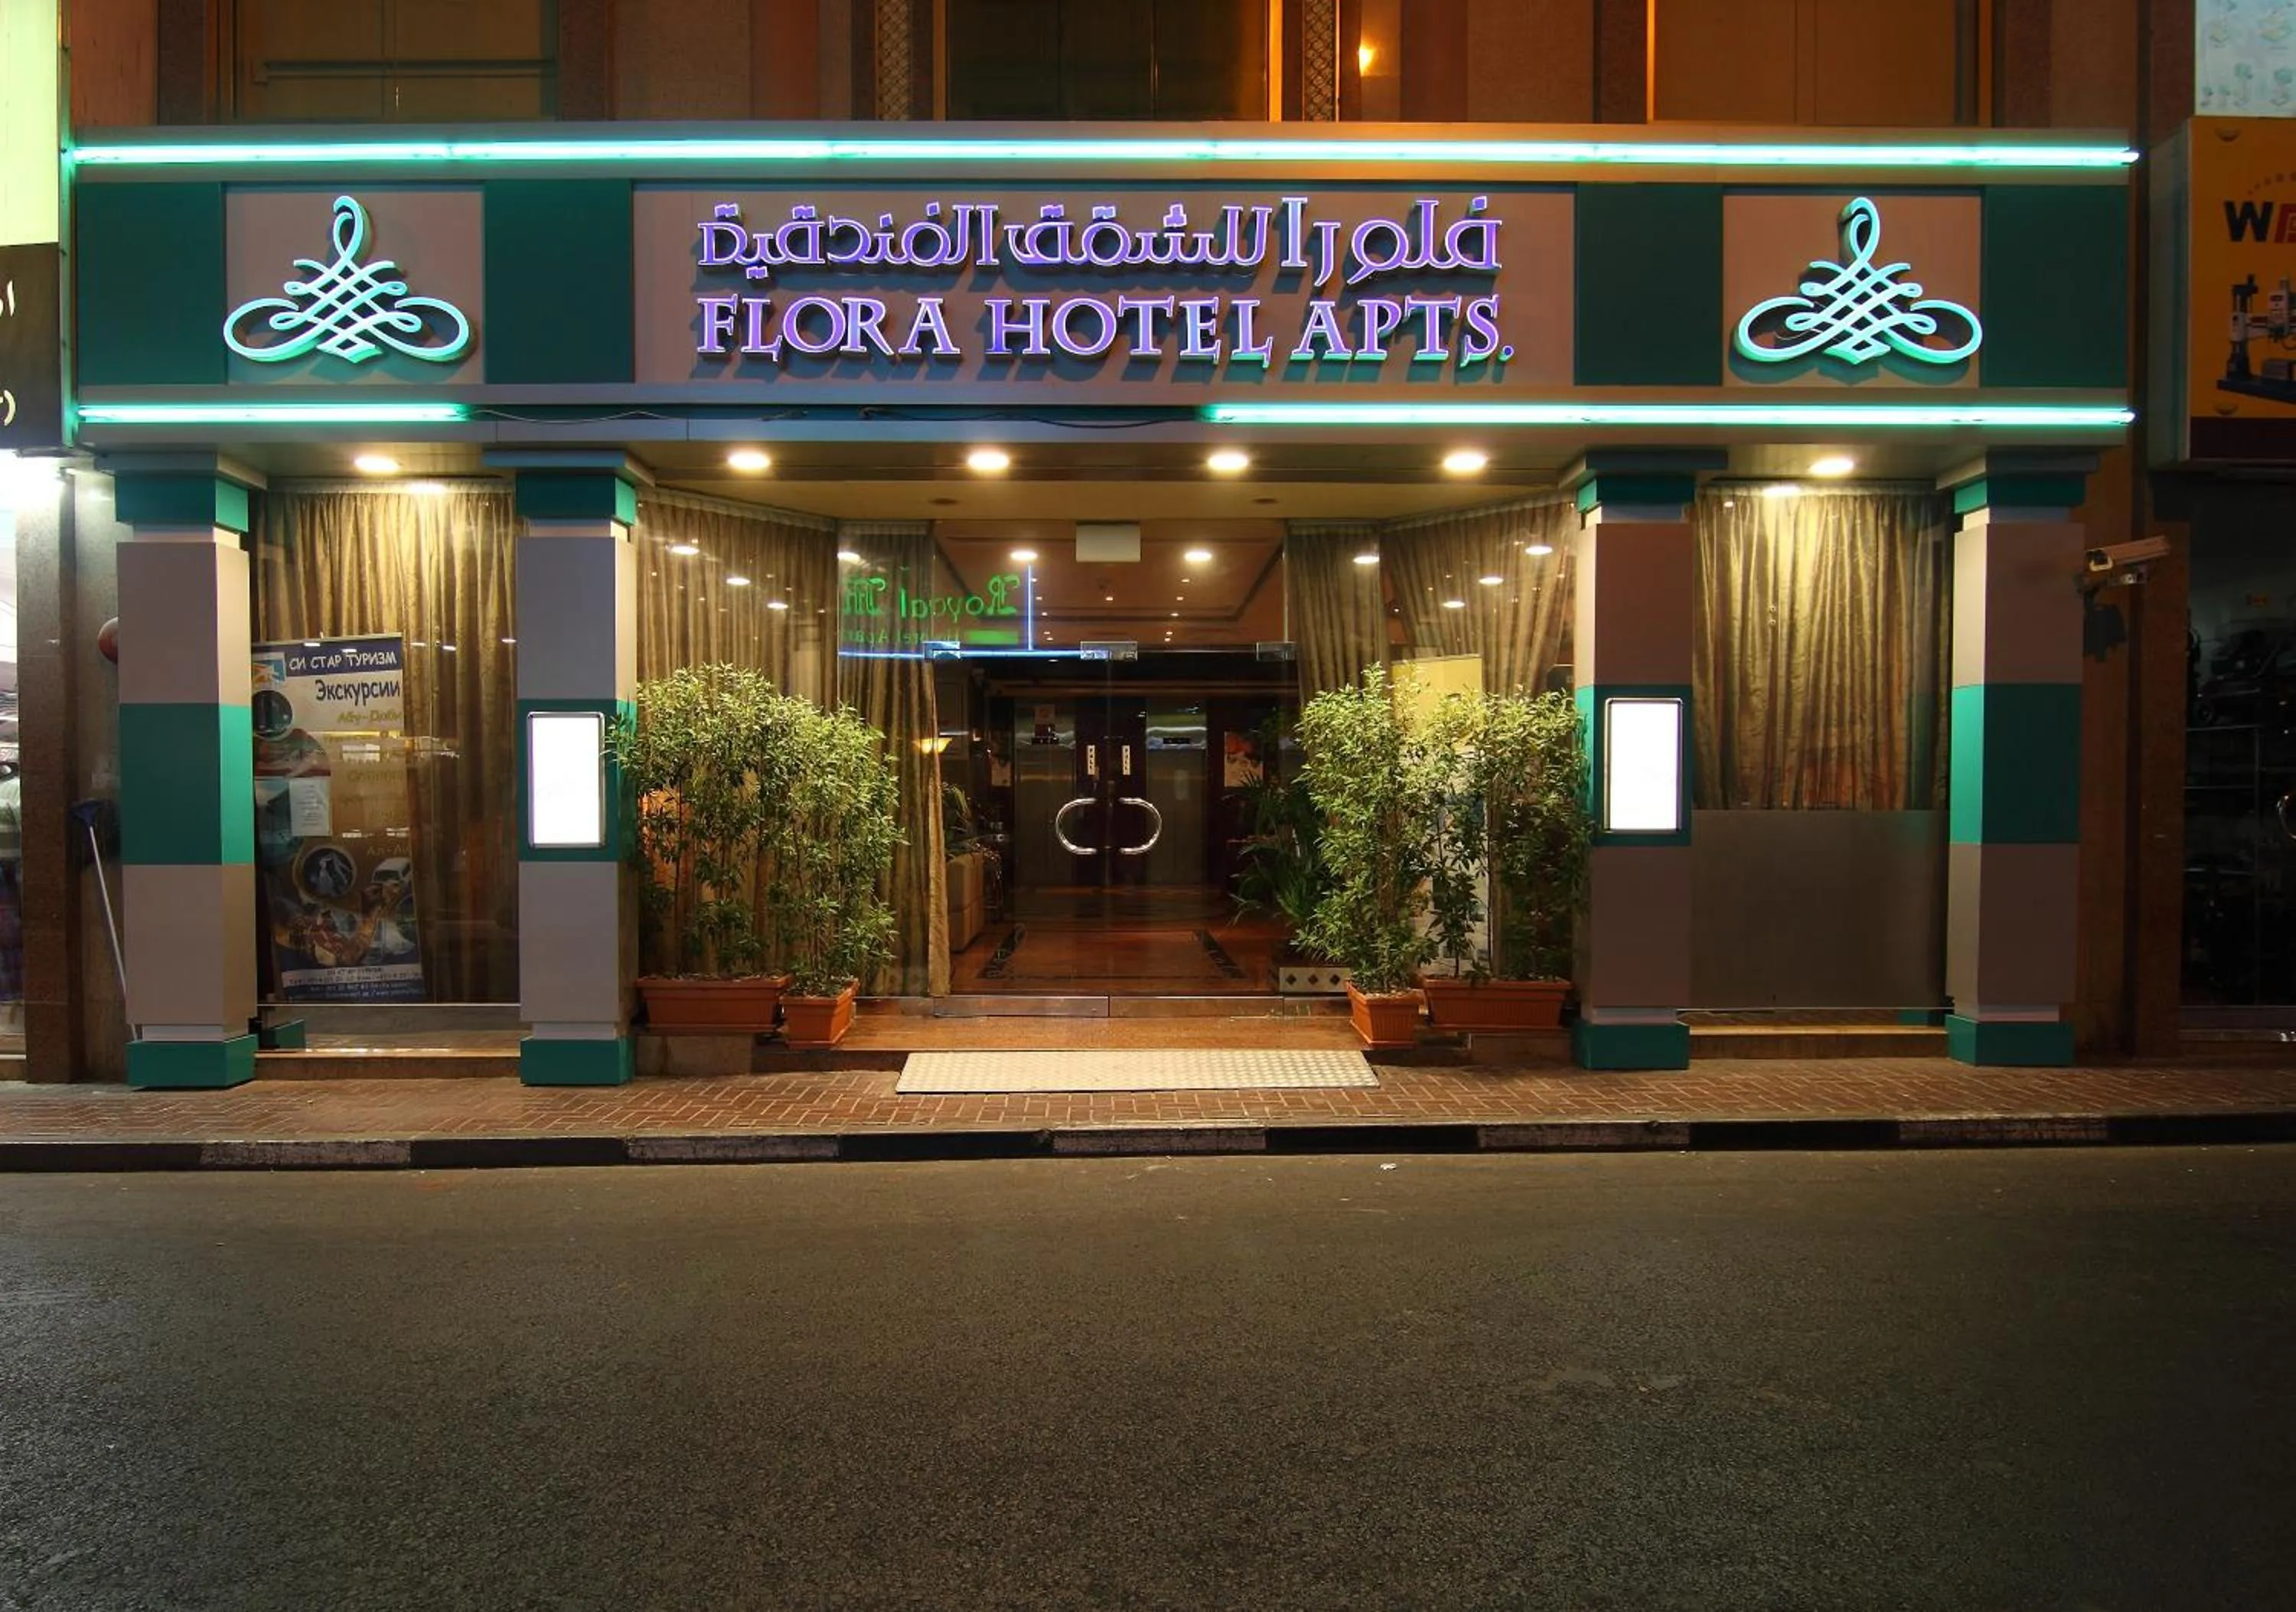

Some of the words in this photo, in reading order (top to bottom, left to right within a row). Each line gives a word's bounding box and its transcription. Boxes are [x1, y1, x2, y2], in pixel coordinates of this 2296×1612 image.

[697, 202, 999, 279] الفندقية
[1003, 203, 1272, 266] للشقق
[1281, 196, 1502, 286] فلورا
[697, 293, 961, 361] FLORA
[985, 295, 1273, 368] HOTEL
[1290, 294, 1515, 367] APTS.
[289, 656, 306, 670] СИ
[310, 654, 343, 670] СТАР
[346, 651, 397, 667] ТУРИЗМ
[315, 679, 400, 706] Экскурсии
